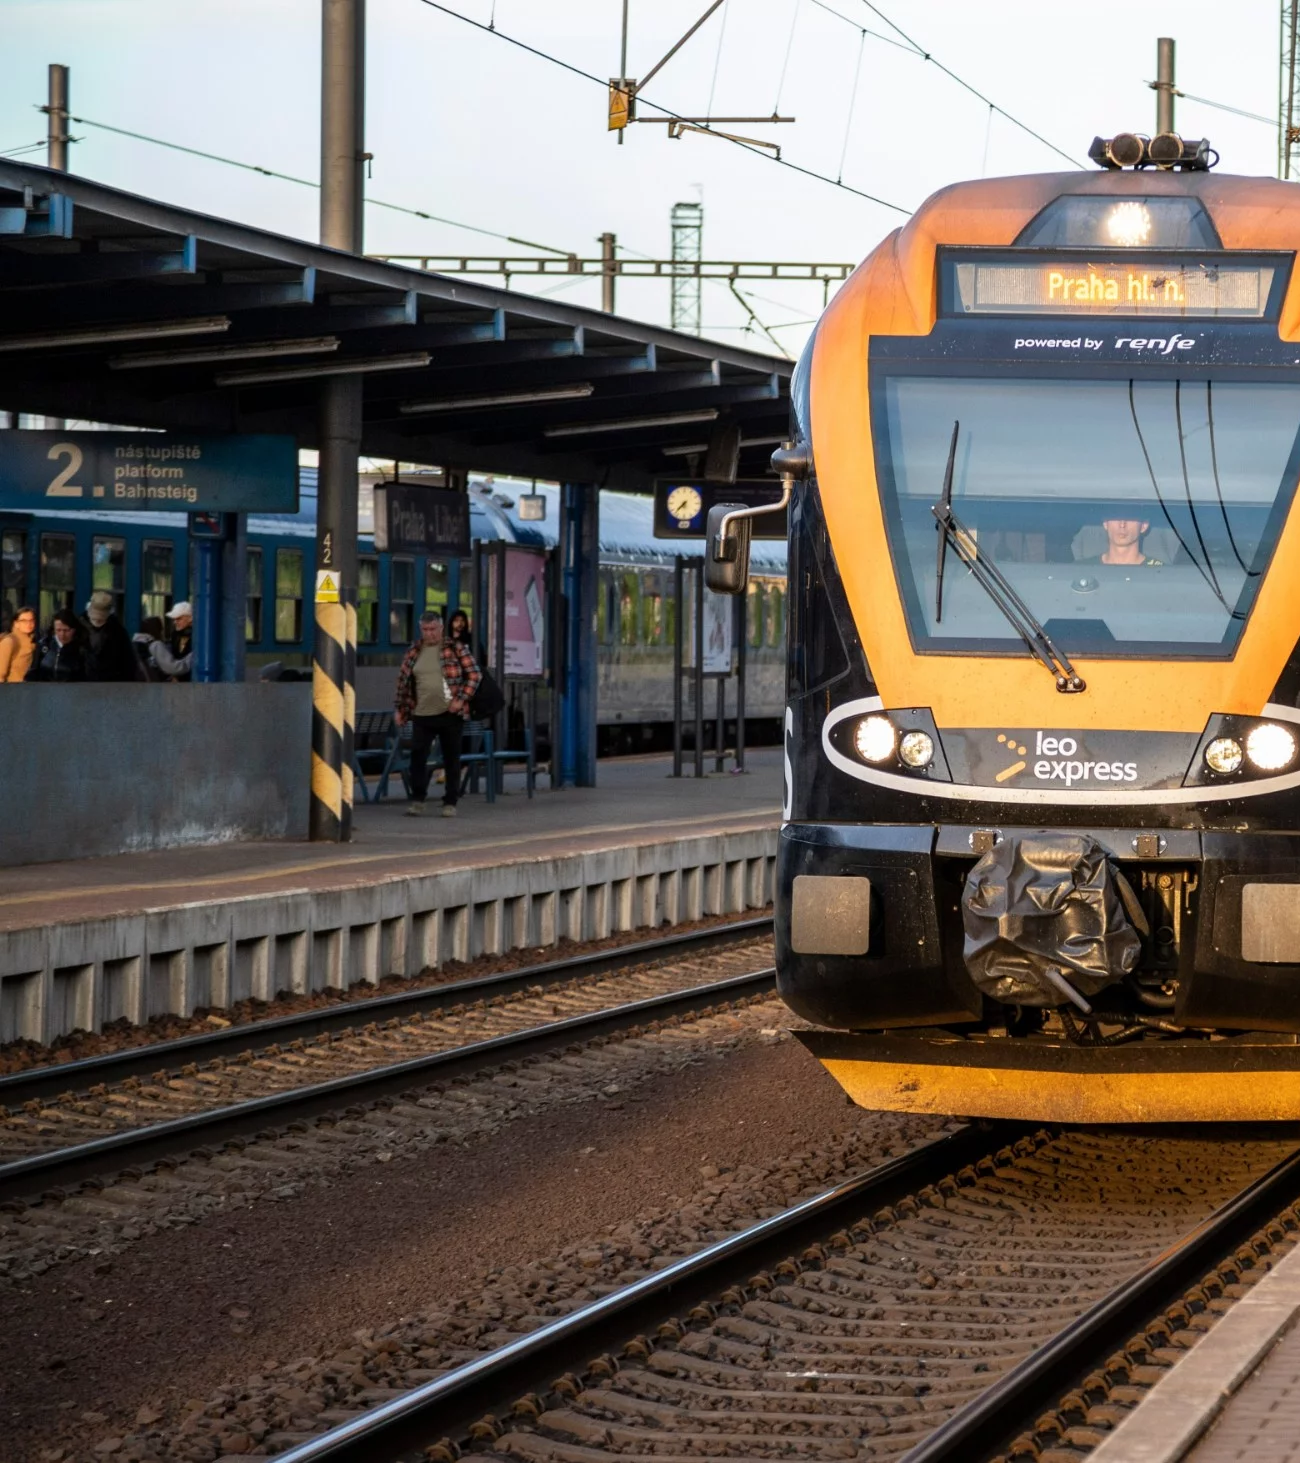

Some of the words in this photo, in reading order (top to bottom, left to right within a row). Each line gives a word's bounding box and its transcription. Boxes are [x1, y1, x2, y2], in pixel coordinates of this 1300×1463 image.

[1049, 272, 1119, 301] Praha
[1127, 274, 1155, 301] hl.
[1164, 279, 1185, 302] n.
[1014, 337, 1082, 350] powered
[1084, 337, 1104, 350] by
[1114, 333, 1196, 355] renfe
[114, 445, 202, 461] nástupiště
[45, 442, 105, 498] 2.
[114, 464, 184, 482] platform
[114, 482, 198, 502] Bahnsteig
[1035, 730, 1078, 757] leo
[1033, 760, 1138, 787] express
